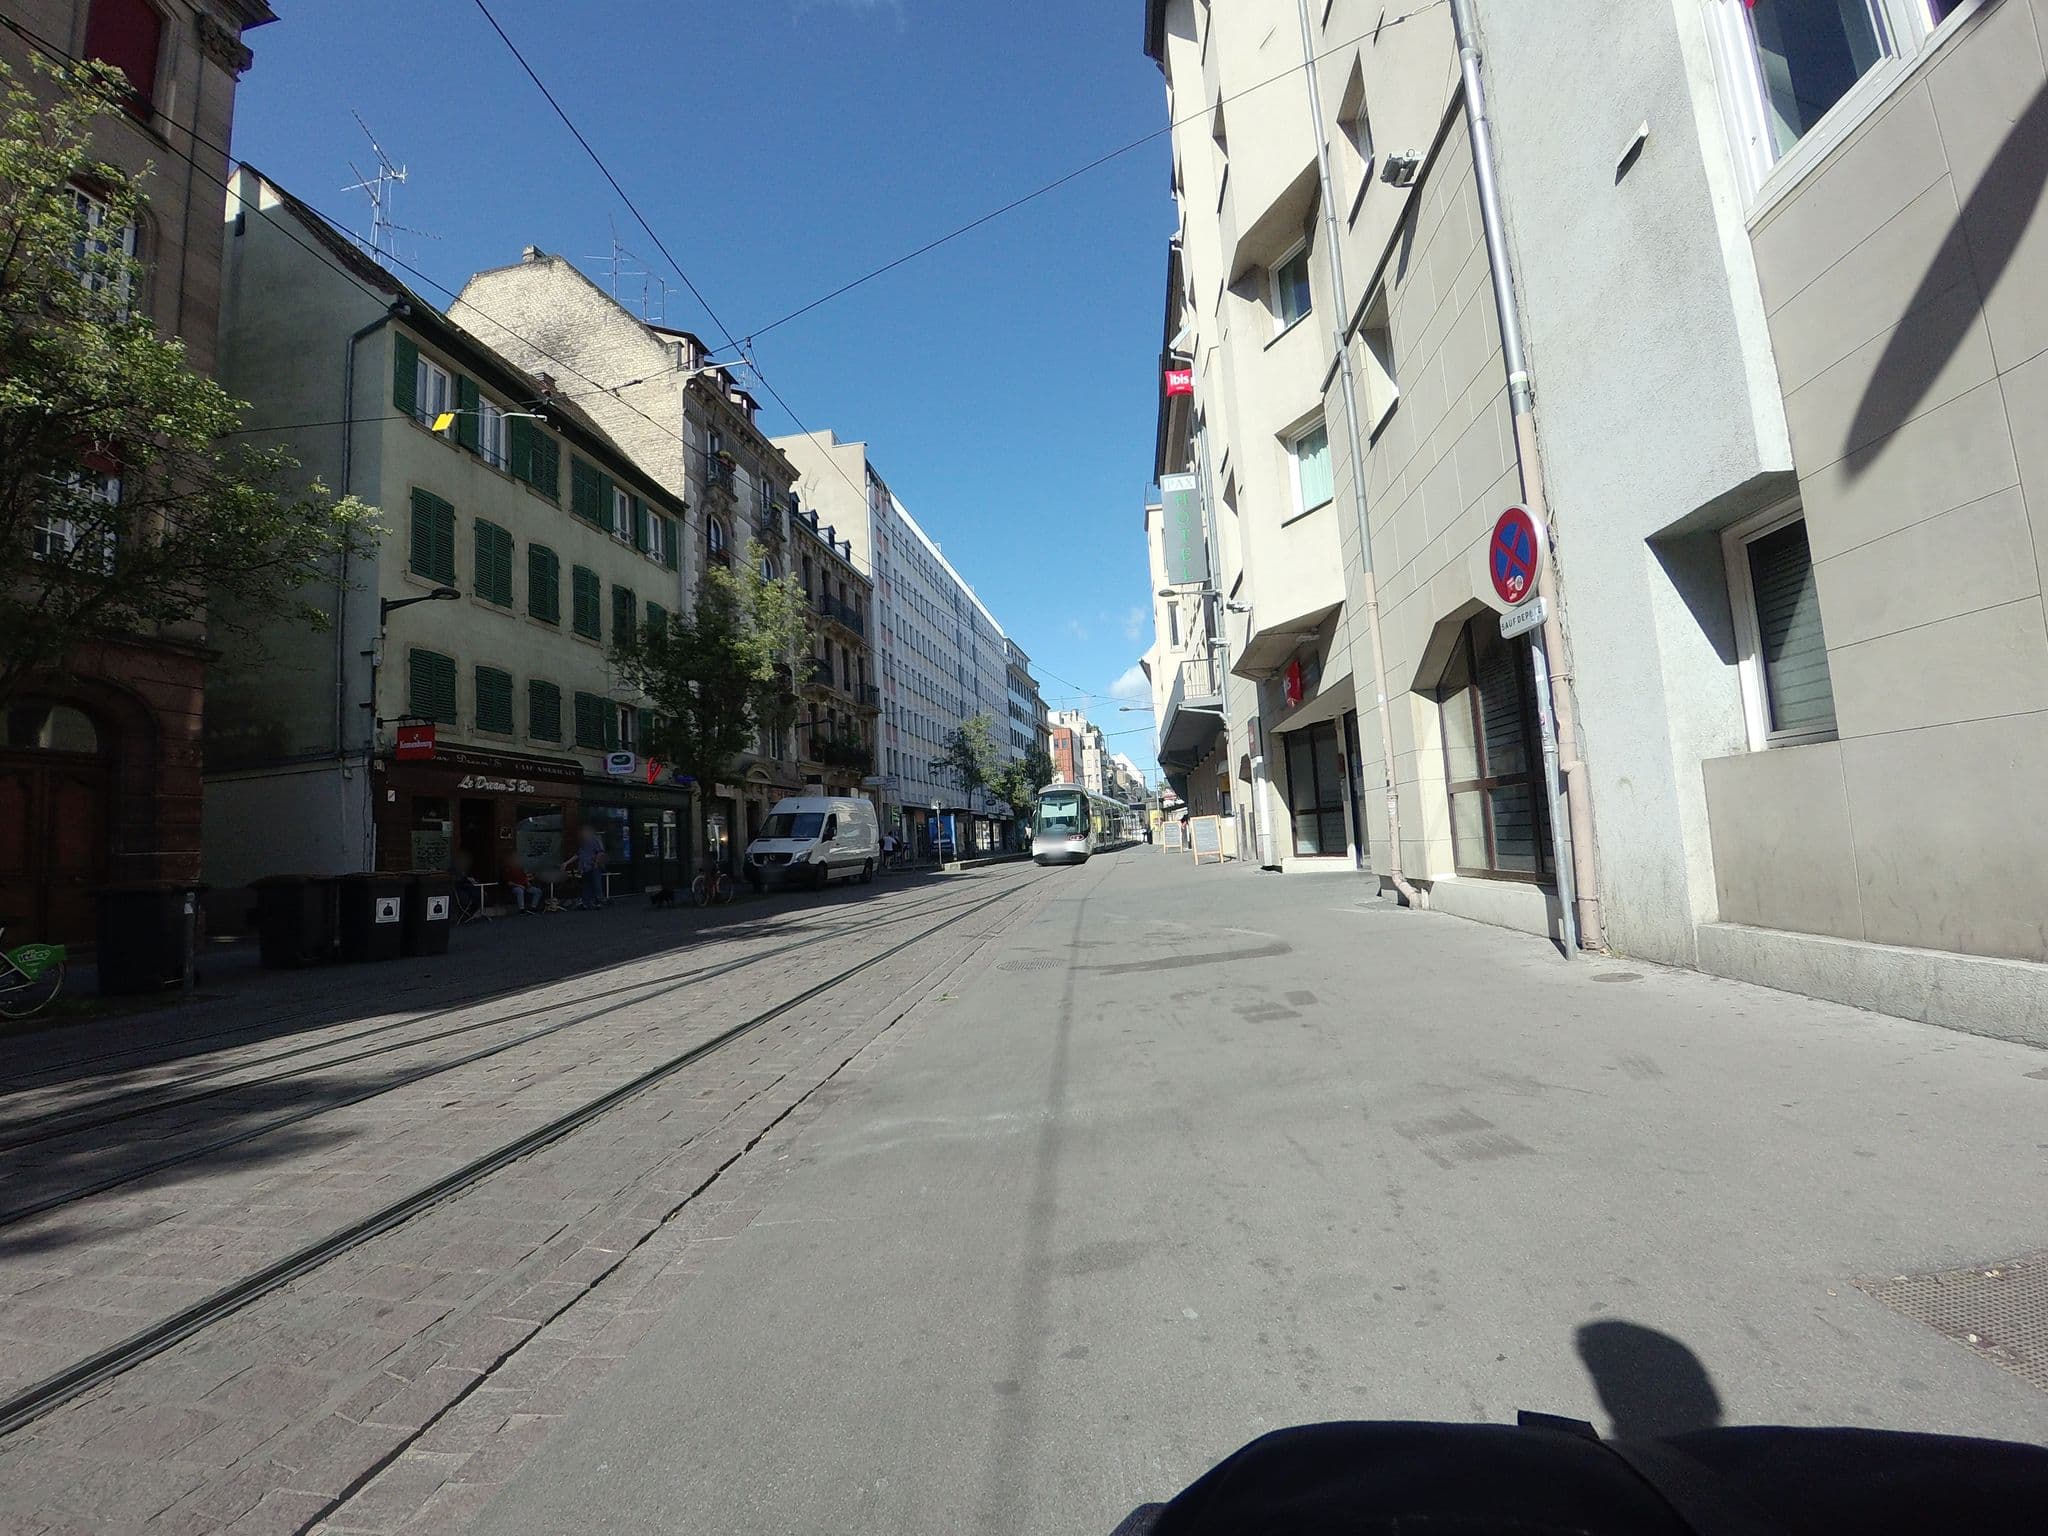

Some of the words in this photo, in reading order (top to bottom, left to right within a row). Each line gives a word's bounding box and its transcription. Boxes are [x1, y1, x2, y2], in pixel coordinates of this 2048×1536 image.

[1169, 373, 1190, 385] ibis
[1166, 476, 1193, 489] PAX
[1175, 491, 1194, 579] HOTEL
[457, 775, 474, 789] Le
[518, 779, 536, 794] Bar
